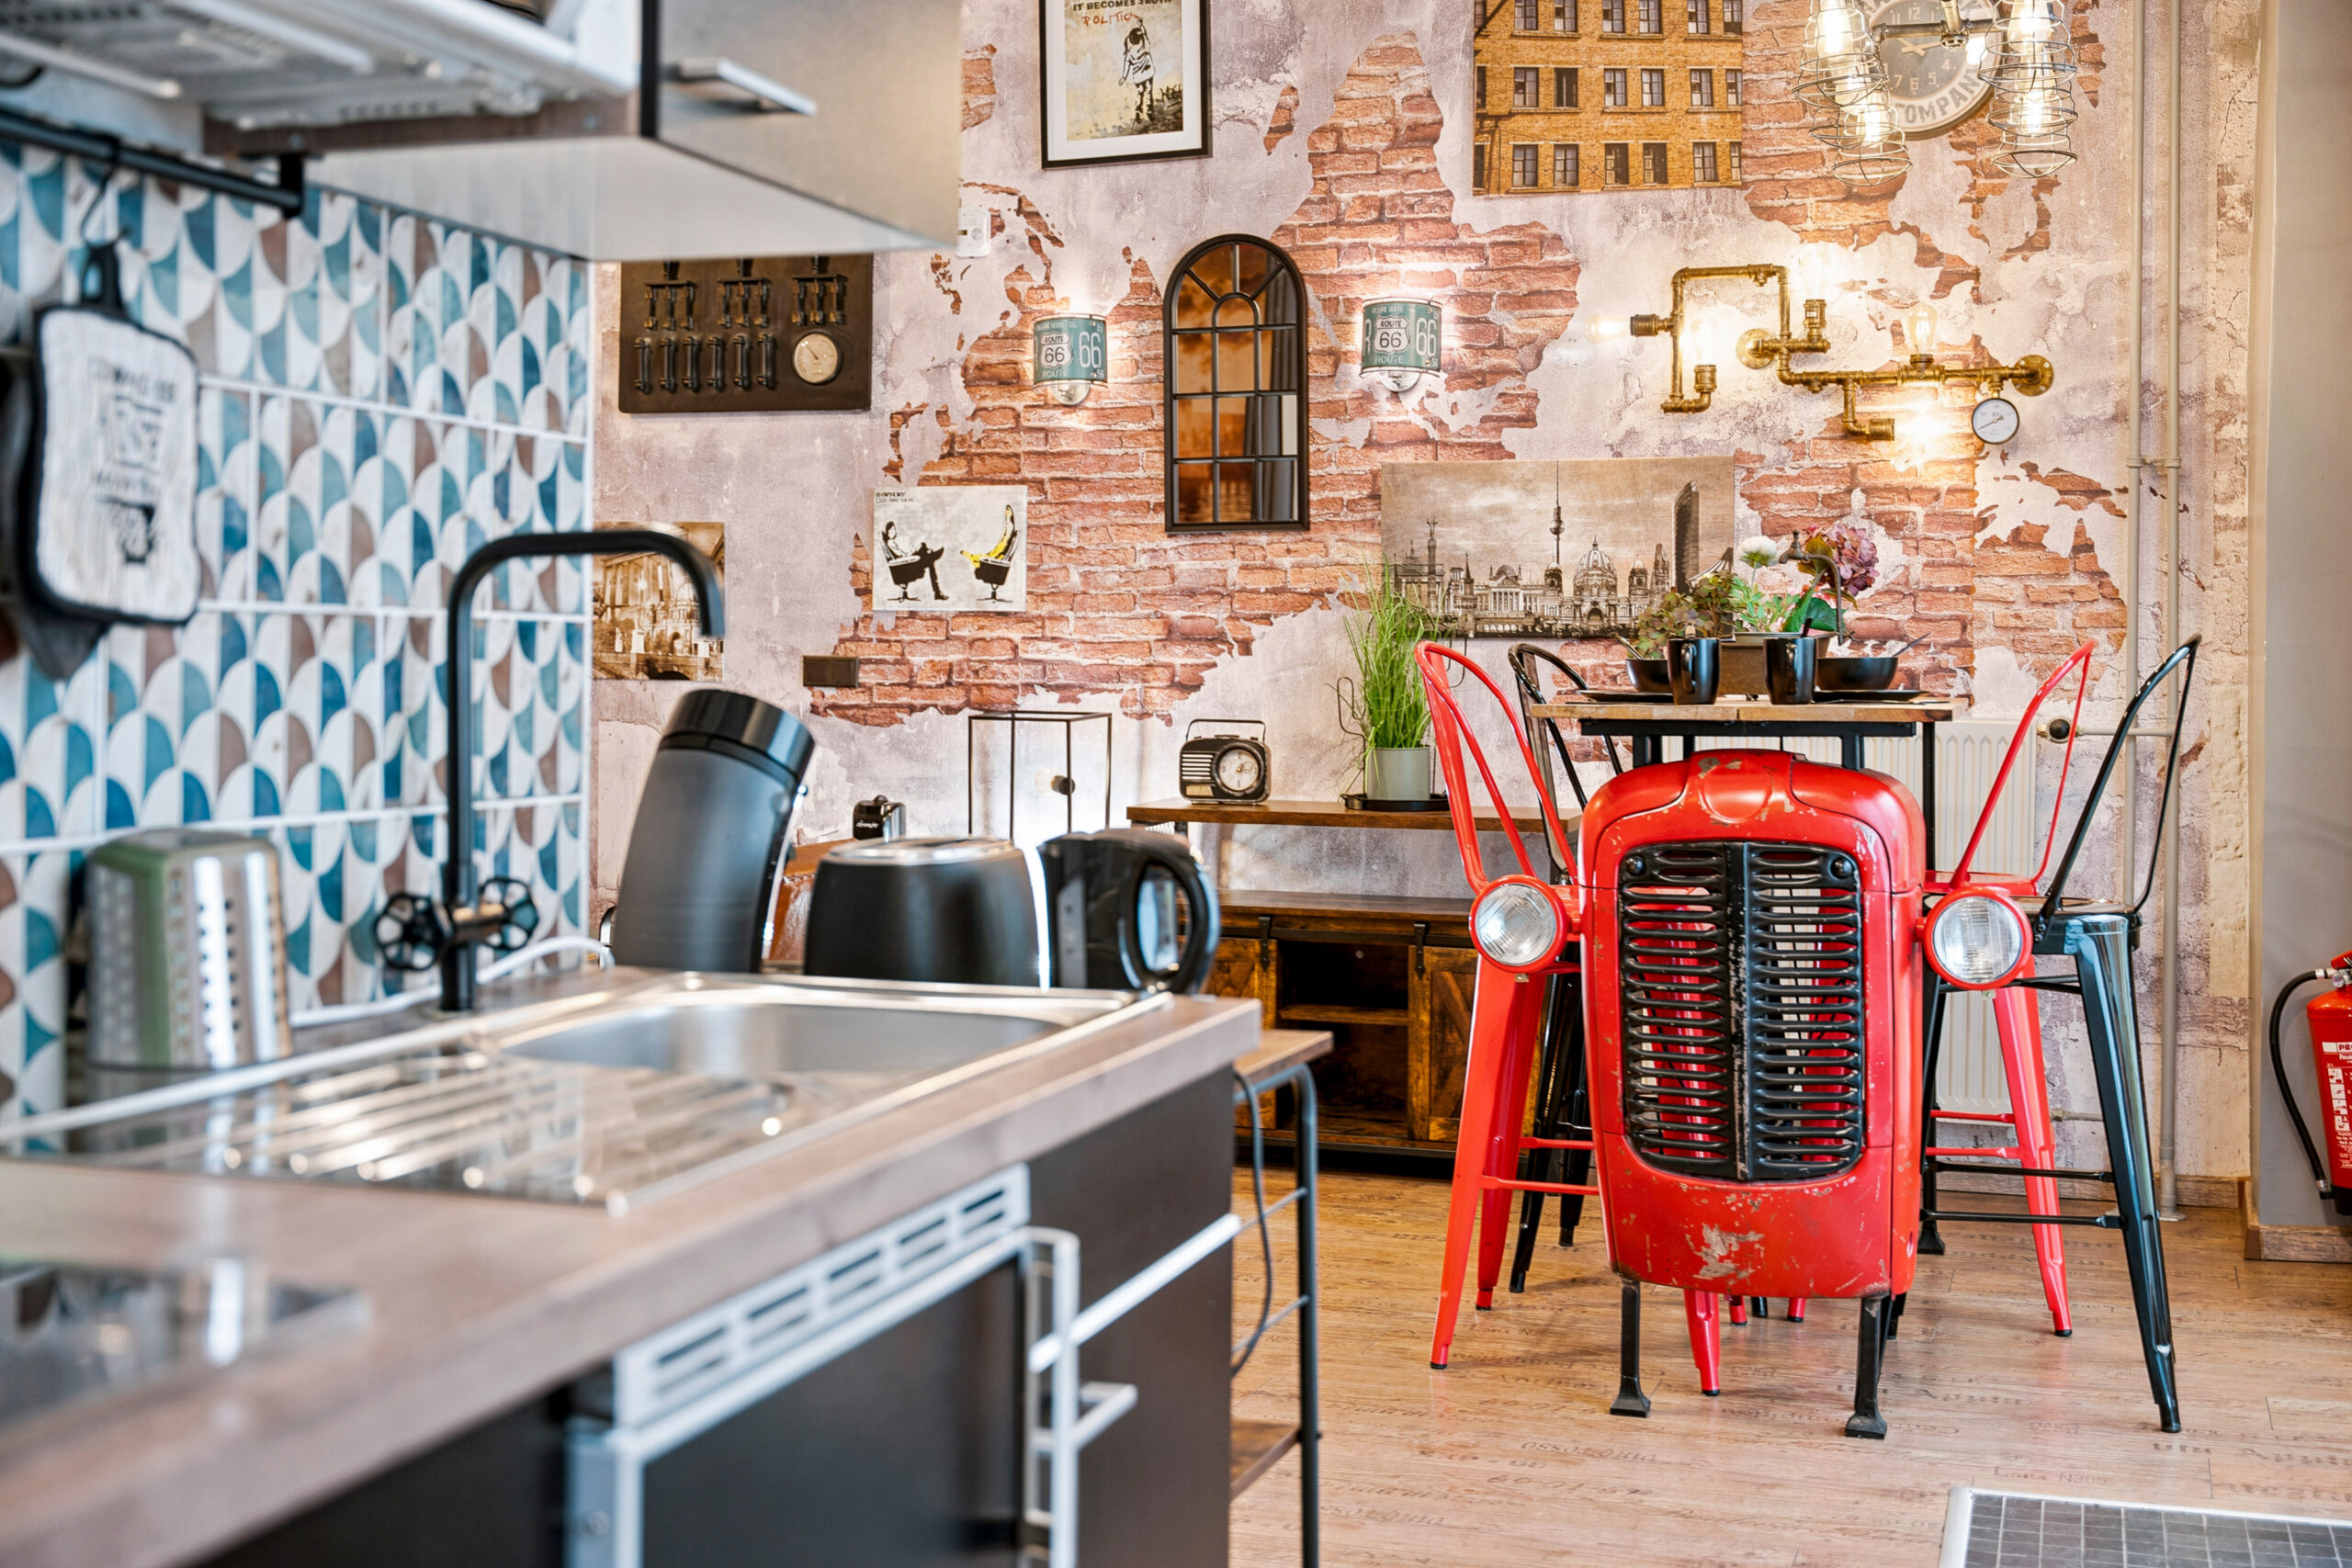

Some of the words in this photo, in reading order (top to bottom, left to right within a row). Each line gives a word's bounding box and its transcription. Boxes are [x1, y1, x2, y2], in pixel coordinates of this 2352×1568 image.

[1086, 0, 1136, 10] BECOMES
[1908, 6, 1921, 20] 12
[1894, 73, 1904, 88] 7
[1909, 77, 1919, 90] 6
[1928, 73, 1937, 85] 5
[1894, 69, 1981, 124] OMPAN
[1380, 320, 1402, 328] ROUTE
[1379, 332, 1402, 348] 66
[1416, 317, 1438, 357] 66
[1045, 346, 1065, 364] 66
[1079, 331, 1102, 368] 66
[1374, 355, 1405, 365] ROUTE
[1042, 369, 1069, 379] ROUTE
